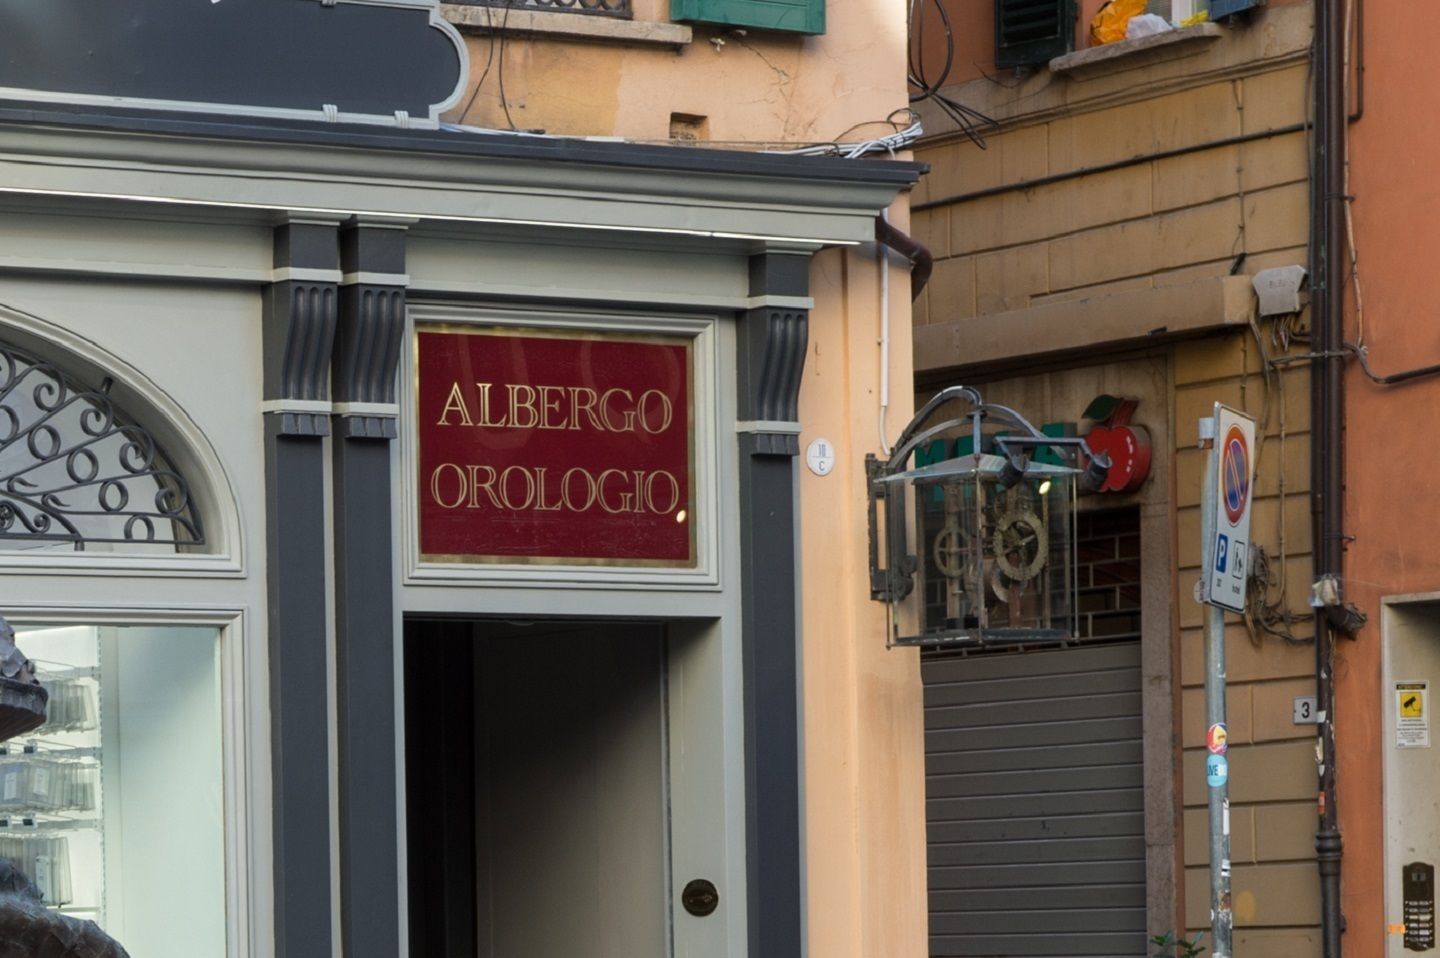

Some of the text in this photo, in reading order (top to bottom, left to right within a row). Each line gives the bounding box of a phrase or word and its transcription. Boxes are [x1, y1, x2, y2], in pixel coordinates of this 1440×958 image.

[437, 381, 673, 434] ALBERGO
[431, 462, 679, 515] OROLOGIO
[1217, 538, 1226, 568] P
[1301, 701, 1310, 719] 3
